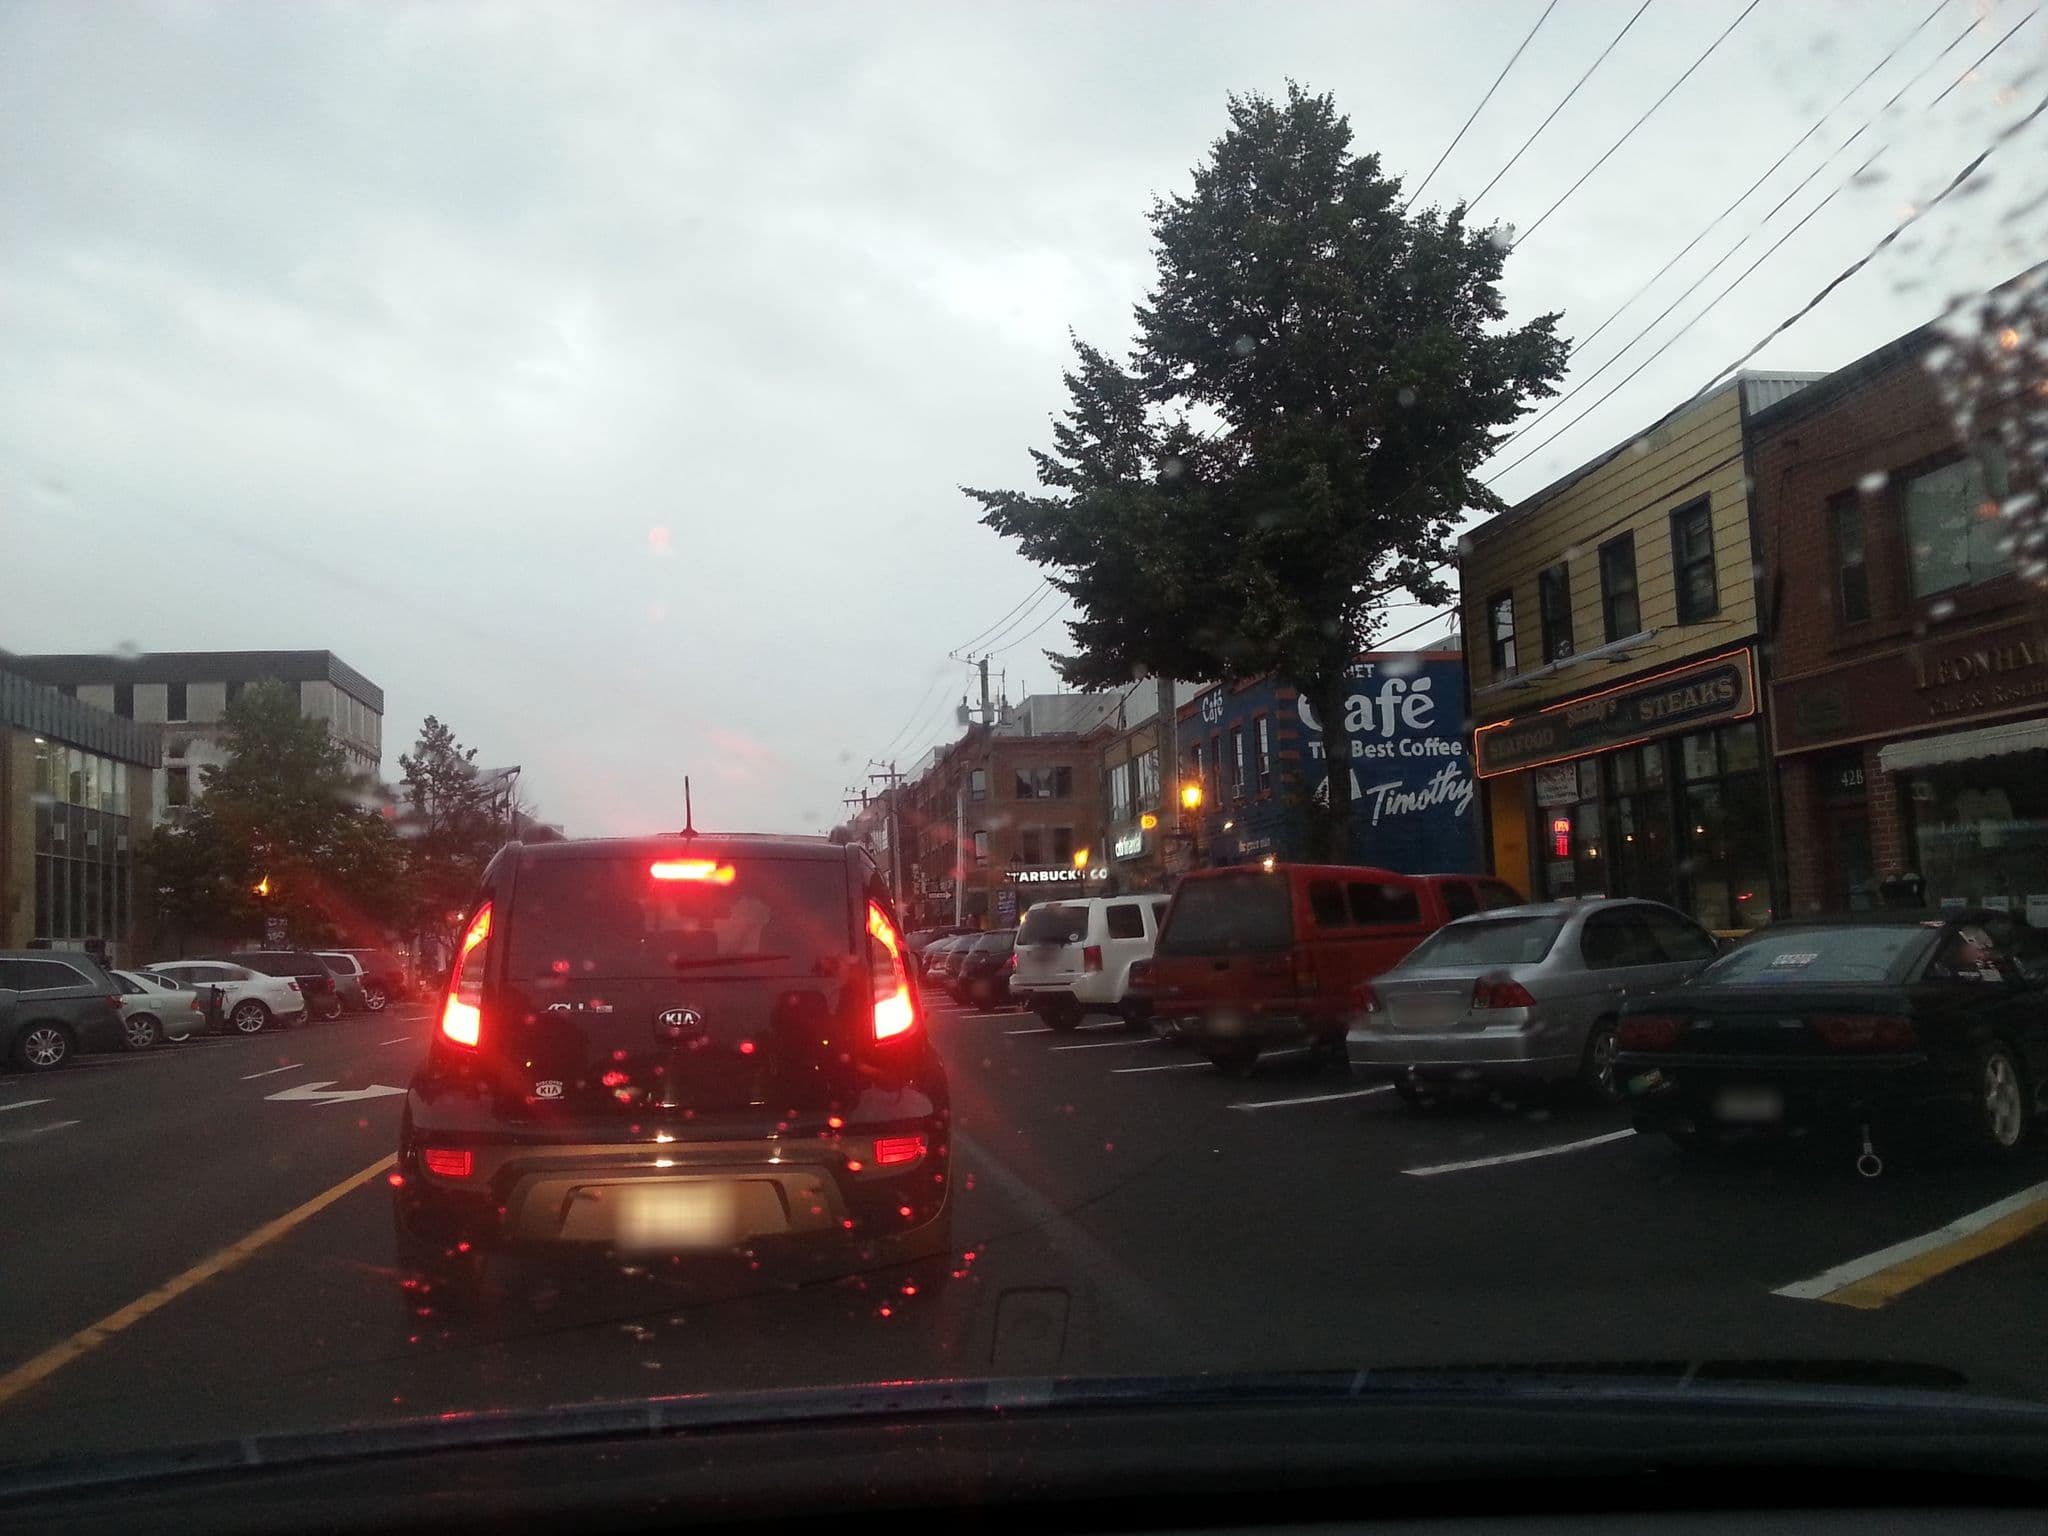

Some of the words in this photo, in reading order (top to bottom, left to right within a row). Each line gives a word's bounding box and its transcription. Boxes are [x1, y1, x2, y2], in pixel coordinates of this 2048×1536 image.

[1913, 637, 2048, 689] LEONHA
[1202, 688, 1224, 724] Café
[1639, 677, 1734, 720] STEAKS
[1351, 739, 1395, 758] Best
[1399, 736, 1463, 757] Coffee
[1366, 760, 1473, 827] Timothy
[1006, 869, 1086, 882] TARBUCK
[665, 1012, 694, 1025] KIA
[540, 1086, 558, 1095] KIA
